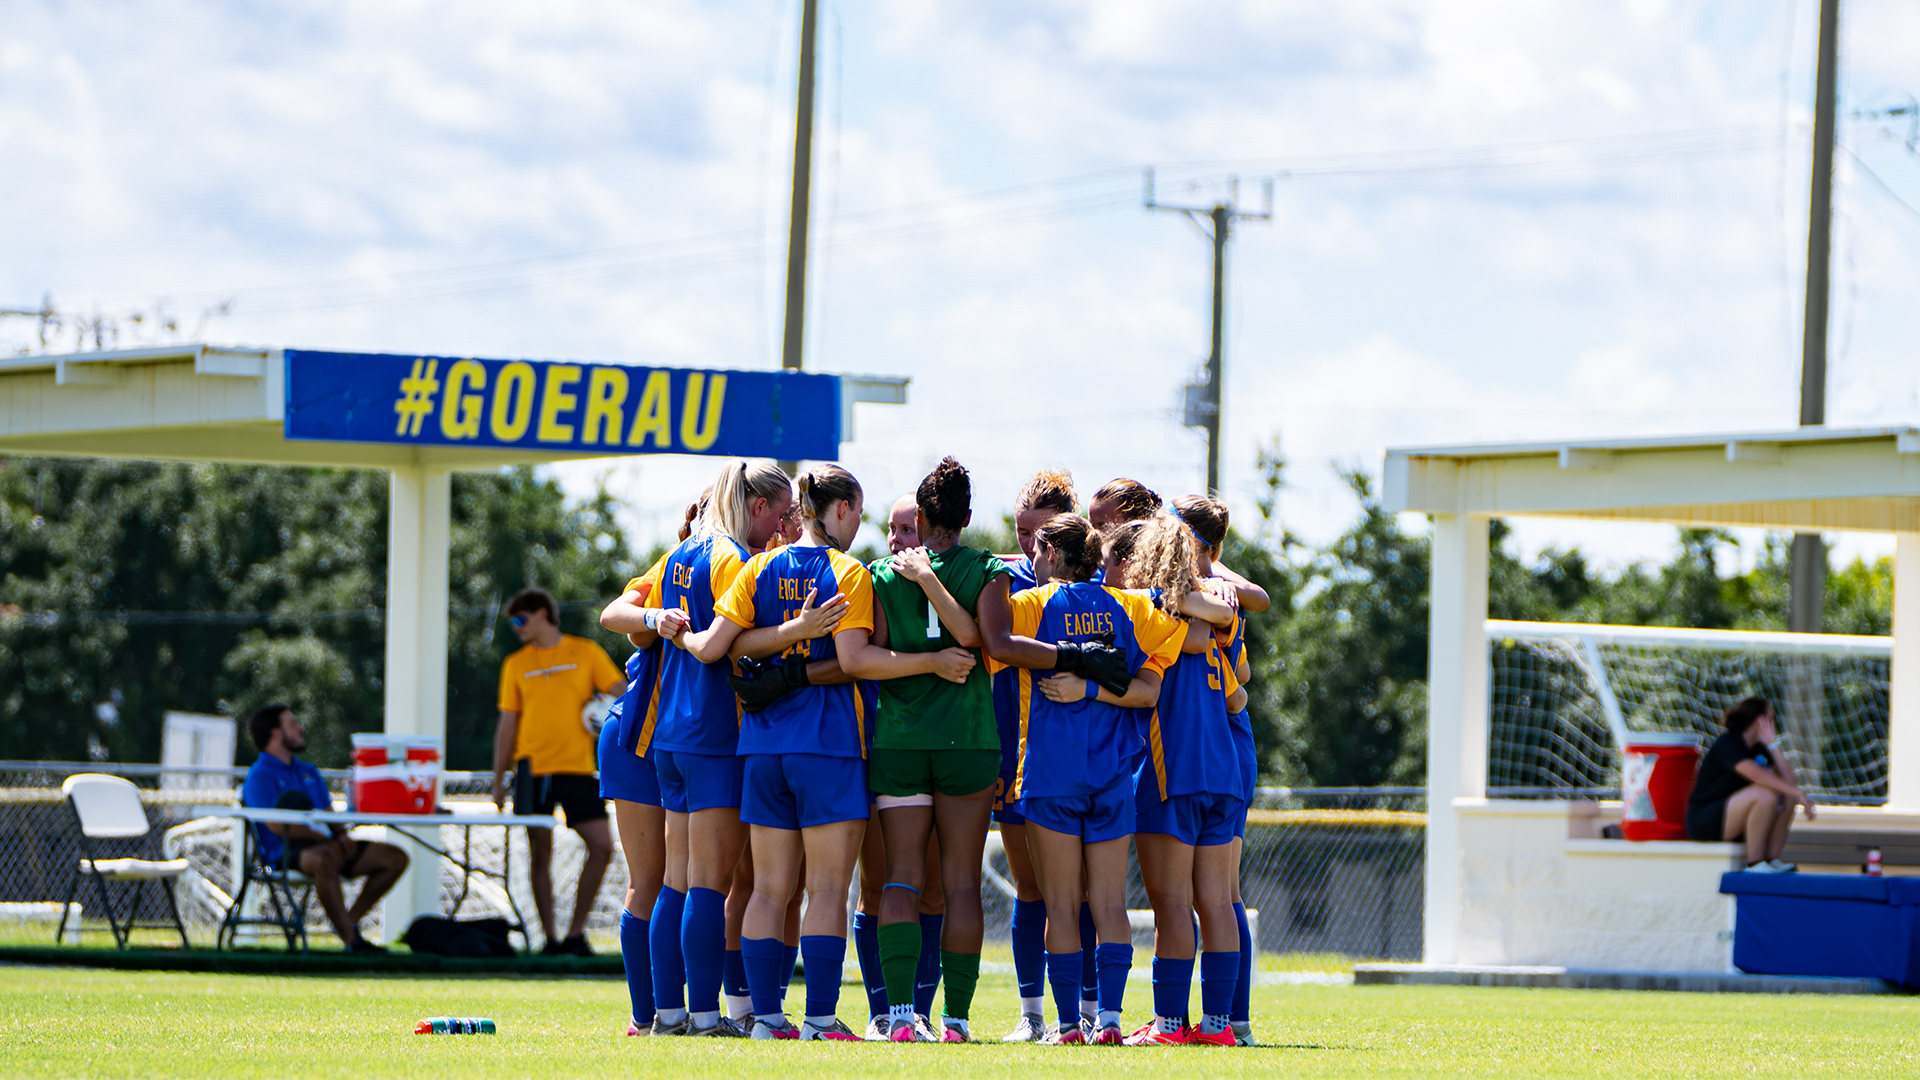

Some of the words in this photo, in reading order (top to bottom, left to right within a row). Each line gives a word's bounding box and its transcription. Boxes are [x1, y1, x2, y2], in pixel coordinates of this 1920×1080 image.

[395, 358, 727, 451] #GOERAU
[926, 599, 941, 638] 1
[1064, 611, 1114, 636] EAGLES
[1205, 637, 1222, 690] 5
